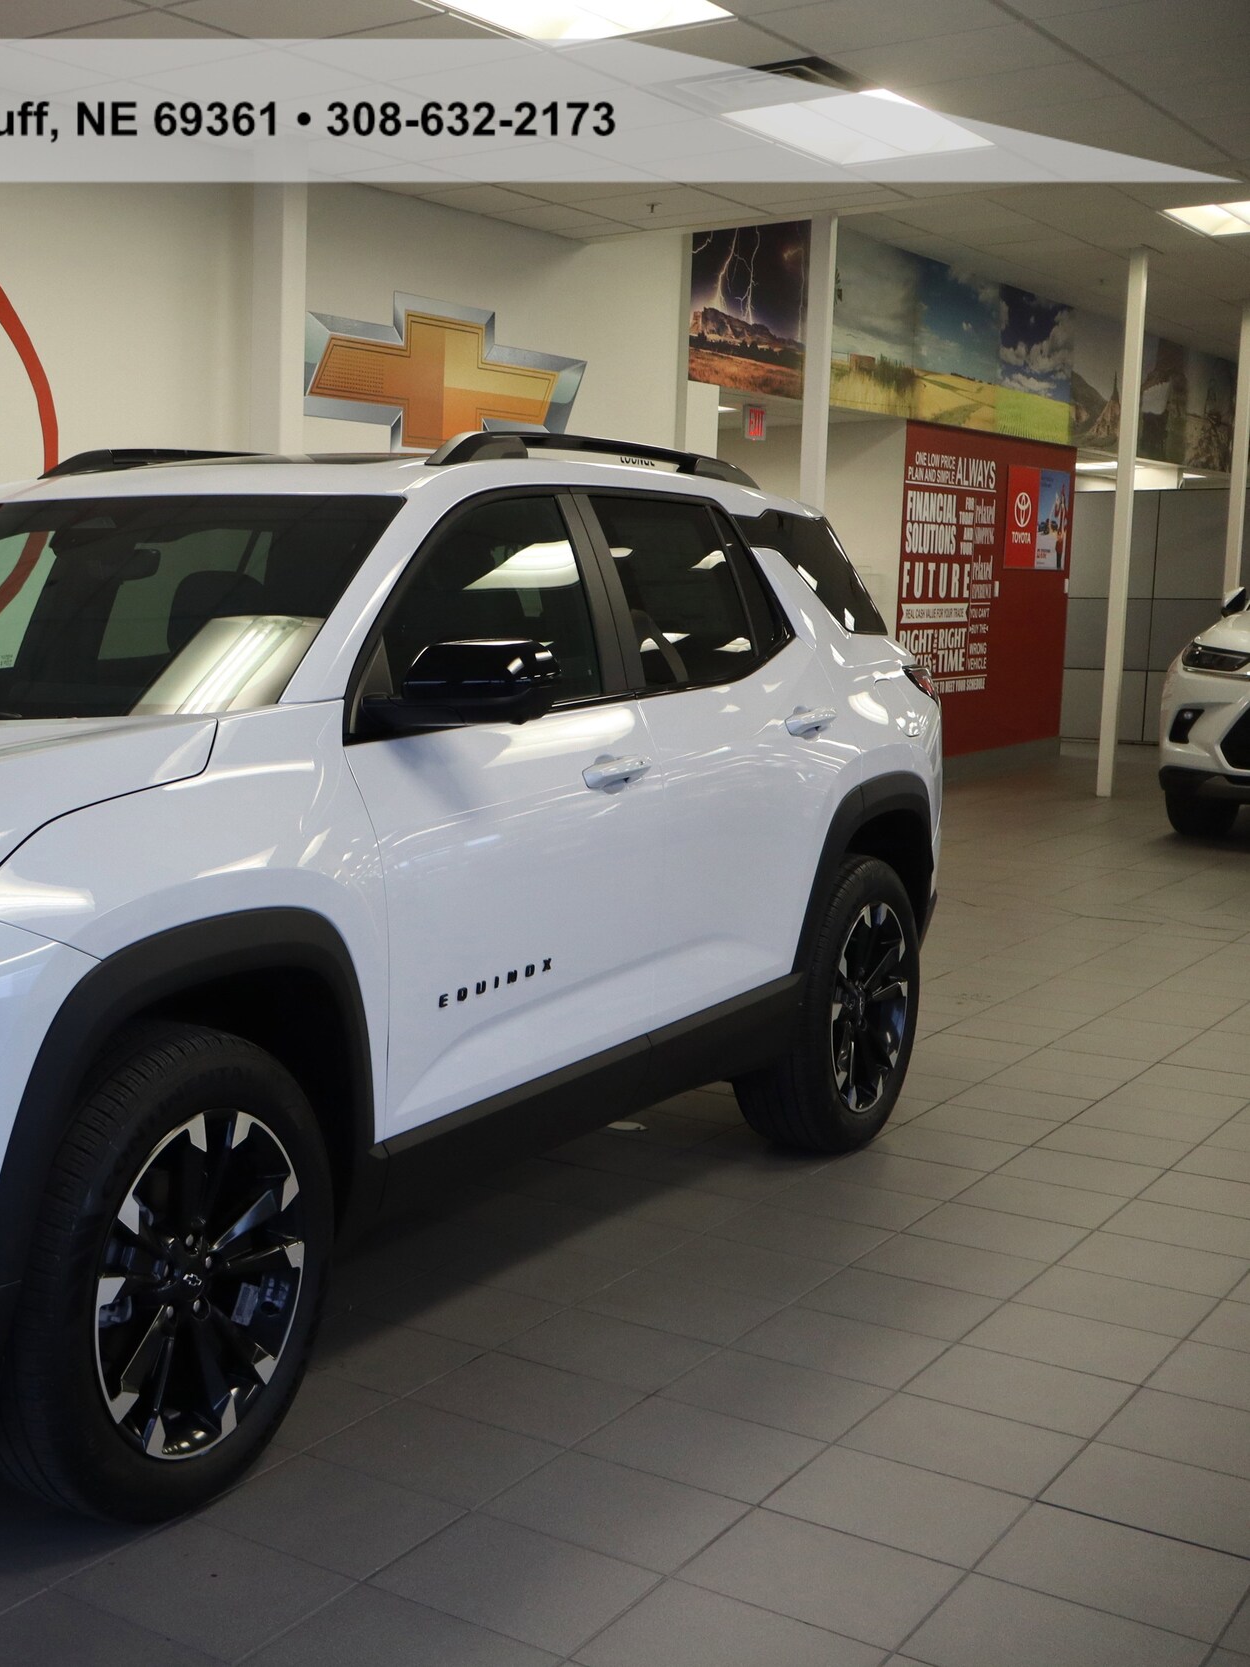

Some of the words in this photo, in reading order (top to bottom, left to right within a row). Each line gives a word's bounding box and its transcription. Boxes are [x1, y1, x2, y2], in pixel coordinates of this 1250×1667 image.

[749, 411, 765, 437] EXIT
[915, 451, 927, 466] ONE
[928, 453, 940, 467] LOW
[941, 454, 956, 470] PRICE
[956, 456, 996, 489] ALWAYS
[908, 466, 924, 480] PLAIN
[924, 468, 936, 482] AND
[937, 470, 955, 485] SIMPLE
[906, 490, 957, 524] FINANCIAL
[905, 521, 957, 556] SOLUTIONS
[1012, 531, 1031, 544] TOYOTA
[902, 561, 971, 599] FUTURE
[899, 629, 933, 654] RIGHT
[938, 628, 967, 649] RIGHT
[937, 649, 965, 673] TIME
[438, 957, 552, 1009] EQUINOX
